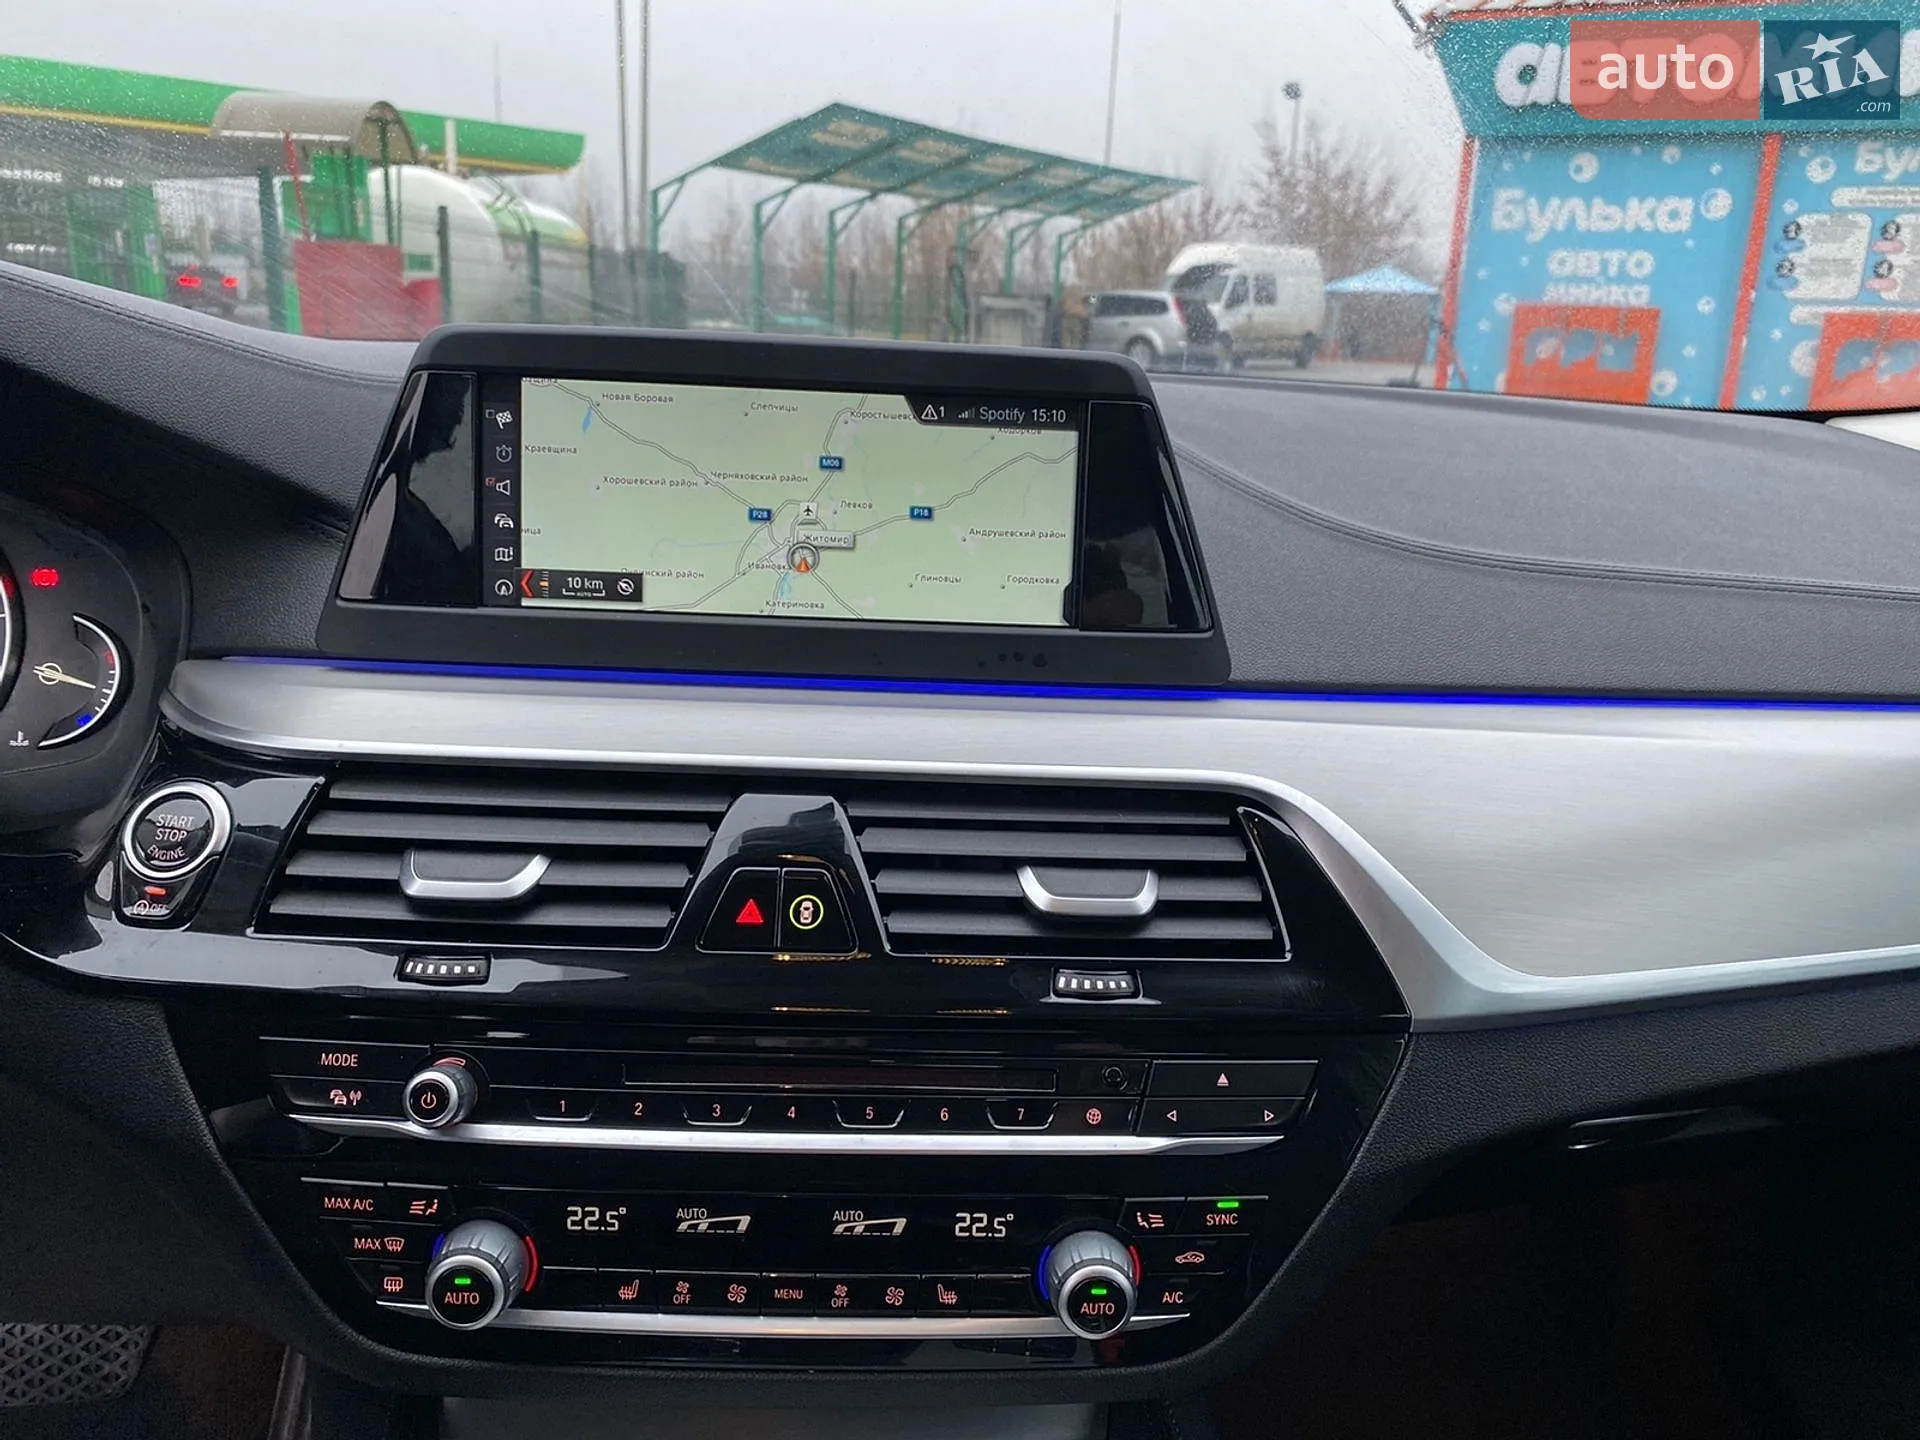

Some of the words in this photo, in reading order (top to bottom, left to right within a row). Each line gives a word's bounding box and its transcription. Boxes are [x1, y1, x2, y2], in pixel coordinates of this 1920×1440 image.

[1491, 187, 1695, 244] Булька
[1546, 247, 1656, 279] авто
[602, 392, 632, 401] Новая
[633, 393, 674, 403] Боровая
[750, 402, 799, 413] Слепчицы
[939, 406, 945, 418] 1
[979, 406, 1025, 424] Spotify
[1031, 409, 1067, 423] 15:10
[524, 444, 577, 455] Краевщина
[603, 475, 666, 487] Хорошевский
[667, 478, 698, 489] район
[711, 471, 778, 482] Черняховский
[780, 474, 808, 484] район
[840, 499, 873, 510] Левков
[802, 533, 850, 545] Житомир
[969, 527, 1037, 539] Андрушевский
[1038, 530, 1066, 540] район
[675, 569, 705, 579] район
[914, 573, 961, 584] Глиновцы
[1006, 574, 1060, 586] Городковка
[567, 577, 582, 589] 10
[584, 577, 604, 589] km
[765, 599, 825, 610] Катериновка
[155, 813, 195, 828] START
[154, 828, 188, 842] STOP
[147, 843, 186, 861] ENGINE
[320, 1053, 359, 1068] MODE
[559, 1100, 566, 1113] 1
[634, 1102, 643, 1116] 2
[712, 1104, 721, 1117] 3
[786, 1106, 796, 1119] 4
[865, 1107, 874, 1120] 5
[940, 1108, 949, 1121] 6
[1017, 1108, 1025, 1121] 7
[324, 1197, 350, 1210] MAX
[353, 1199, 374, 1212] A/C
[566, 1206, 627, 1231] 22.5°
[675, 1208, 708, 1220] AUTO
[832, 1210, 864, 1222] AUTO
[1206, 1213, 1239, 1226] SYNC
[954, 1212, 1015, 1238] 22.5°
[353, 1238, 381, 1250] MAX
[444, 1292, 480, 1305] AUTO
[672, 1293, 691, 1304] OFF
[774, 1288, 803, 1300] MENU
[1161, 1291, 1184, 1304] A/C
[831, 1297, 850, 1308] OFF
[1080, 1302, 1115, 1315] AUTO
